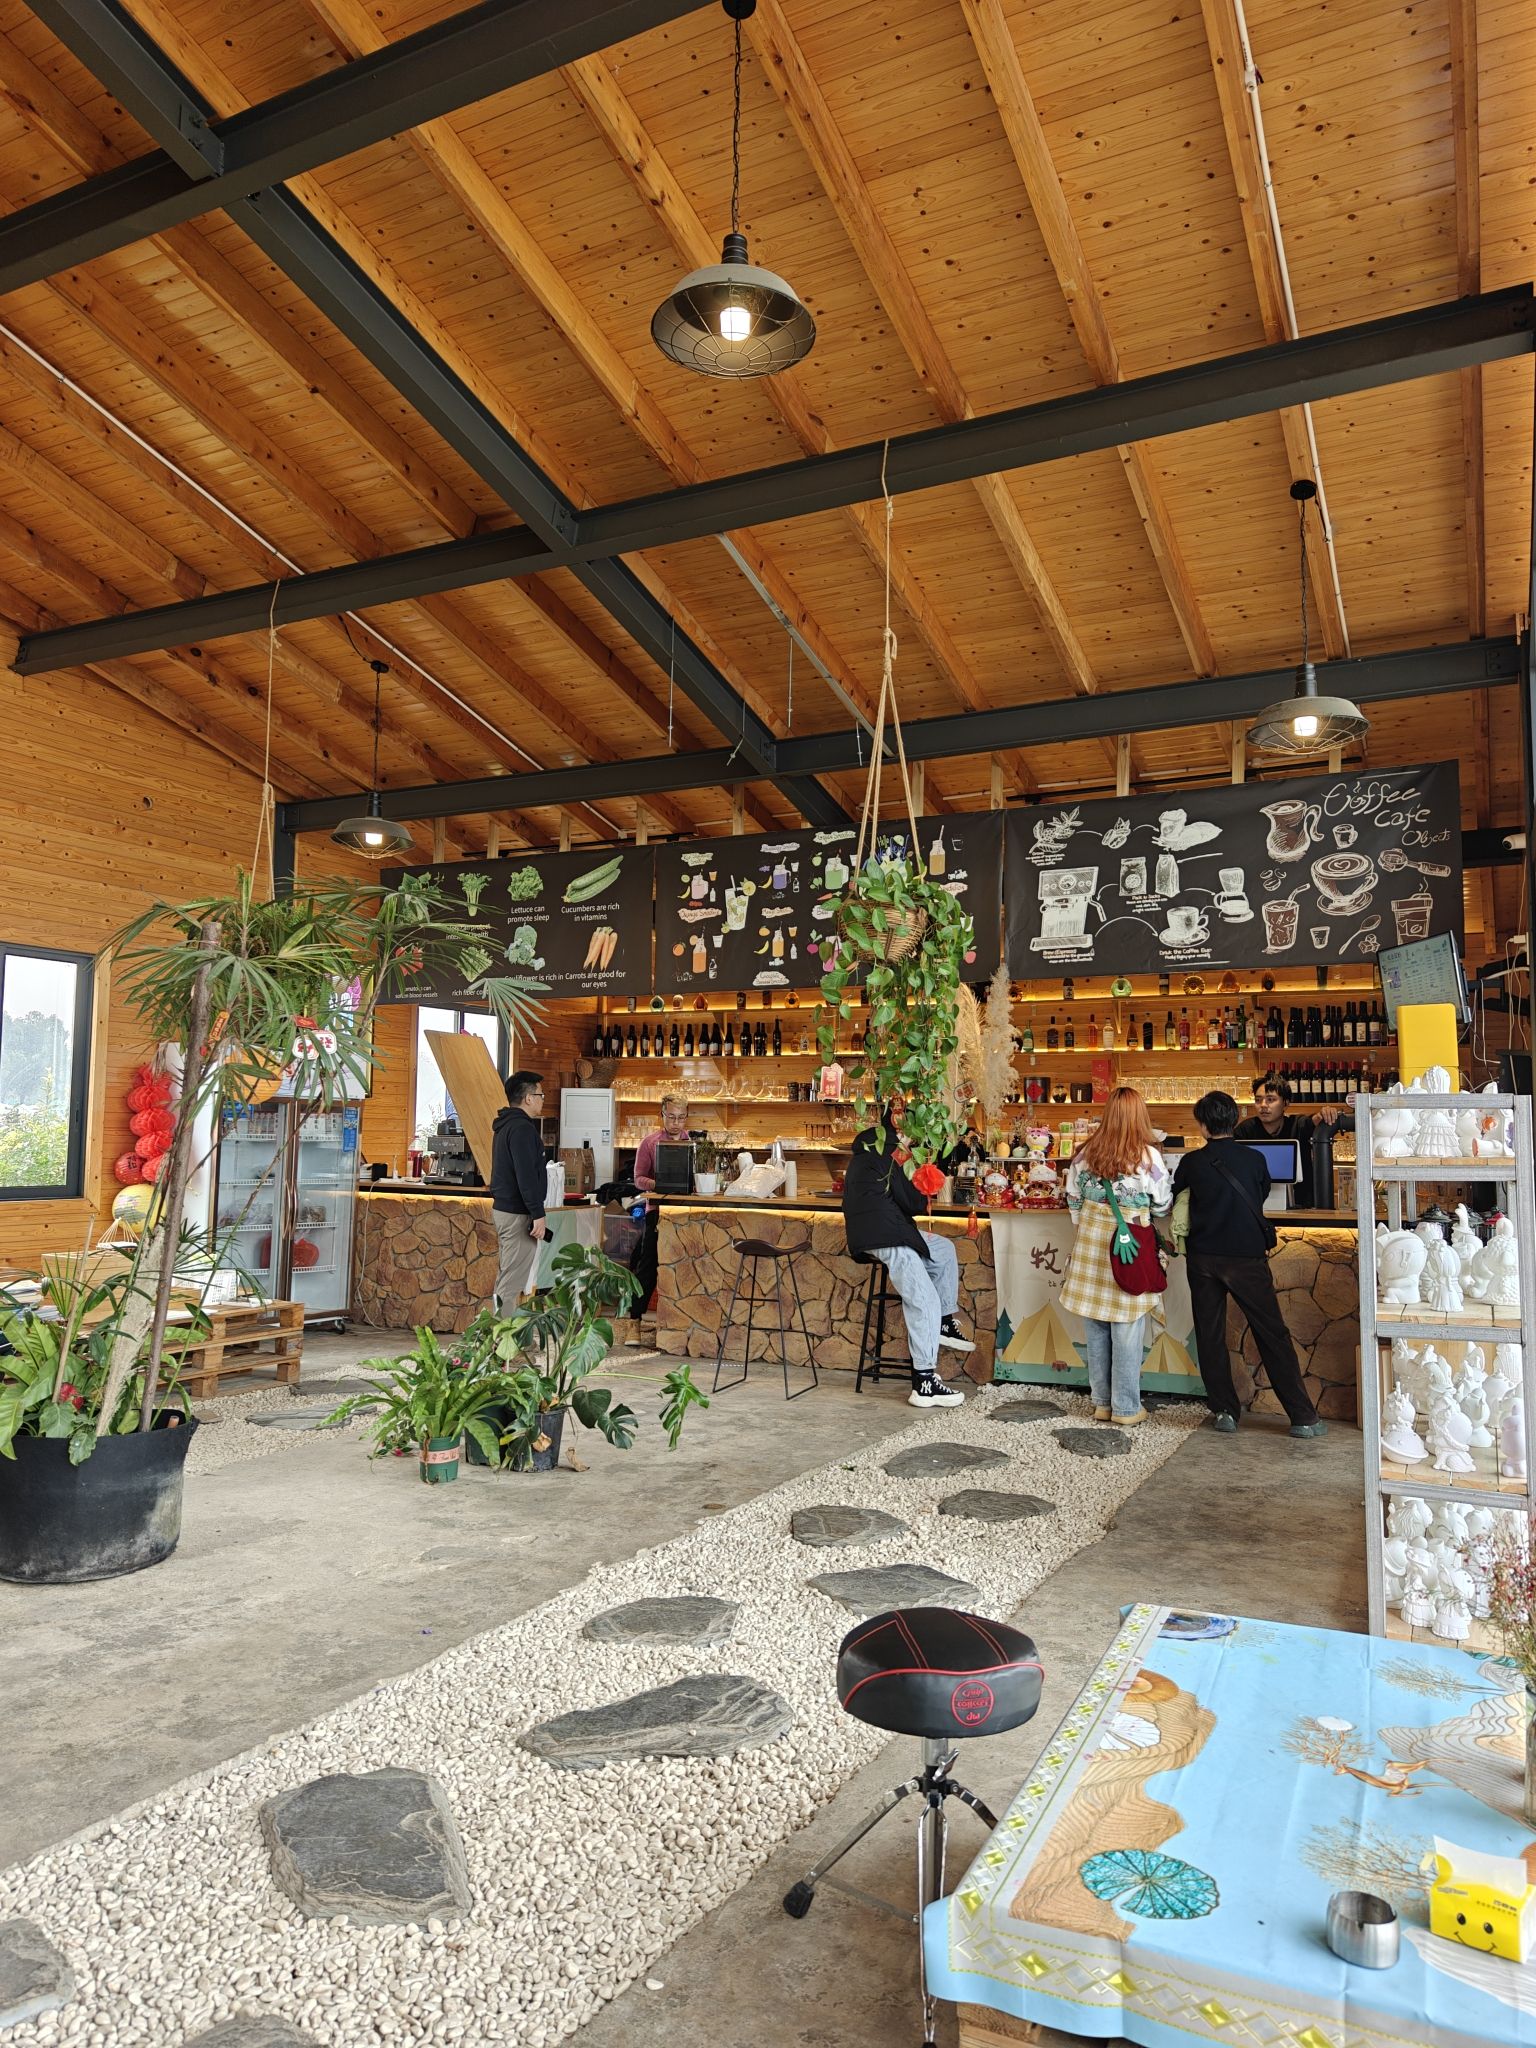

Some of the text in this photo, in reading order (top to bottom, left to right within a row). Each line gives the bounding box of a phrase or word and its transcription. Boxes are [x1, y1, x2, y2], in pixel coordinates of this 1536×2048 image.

[1321, 781, 1421, 817] Coffee
[1402, 829, 1452, 848] Objects
[511, 906, 533, 914] Lettuce
[561, 902, 620, 914] Cucumbers are rich
[507, 913, 550, 924] promote sleep
[574, 913, 607, 922] in vitamins
[546, 973, 557, 981] rich
[565, 972, 586, 980] Carrots
[598, 970, 615, 980] good
[593, 981, 607, 989] eyes
